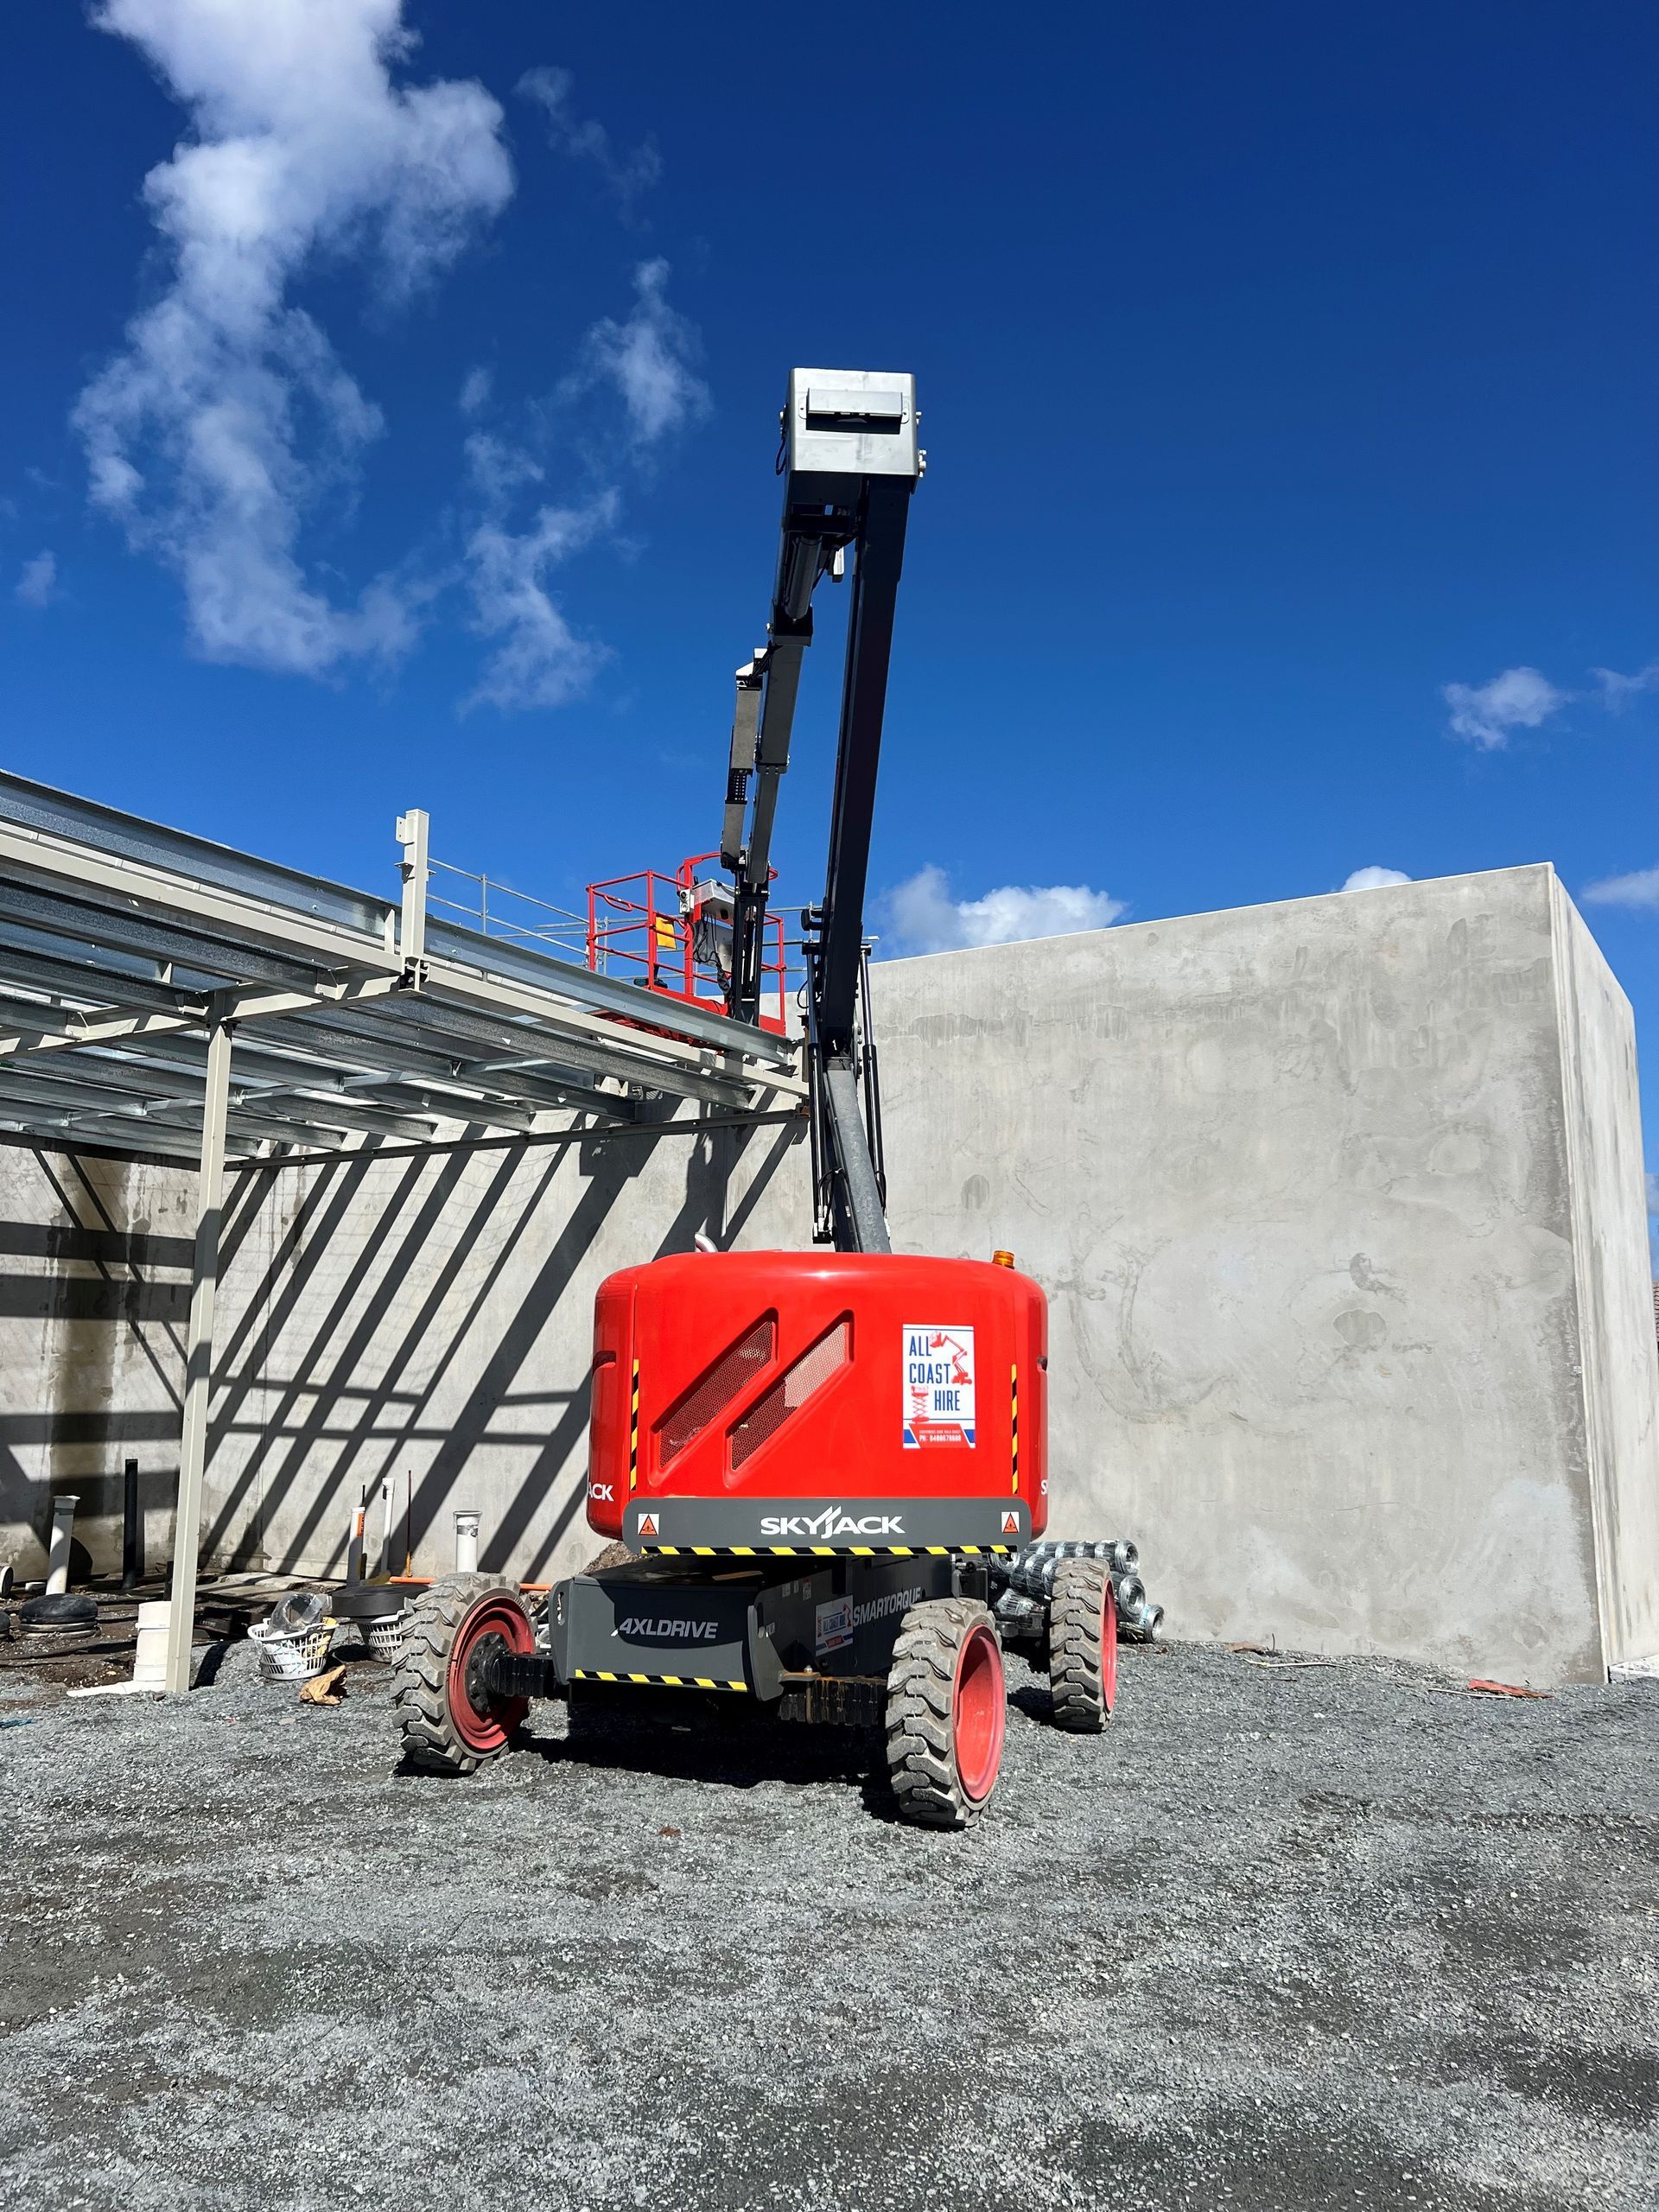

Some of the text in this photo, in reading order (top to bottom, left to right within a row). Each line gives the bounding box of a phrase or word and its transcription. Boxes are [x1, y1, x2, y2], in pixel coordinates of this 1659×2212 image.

[909, 1335, 931, 1357] ALL
[909, 1363, 950, 1384] COAST
[934, 1389, 961, 1411] HIRE
[760, 1505, 906, 1539] SKYJACK
